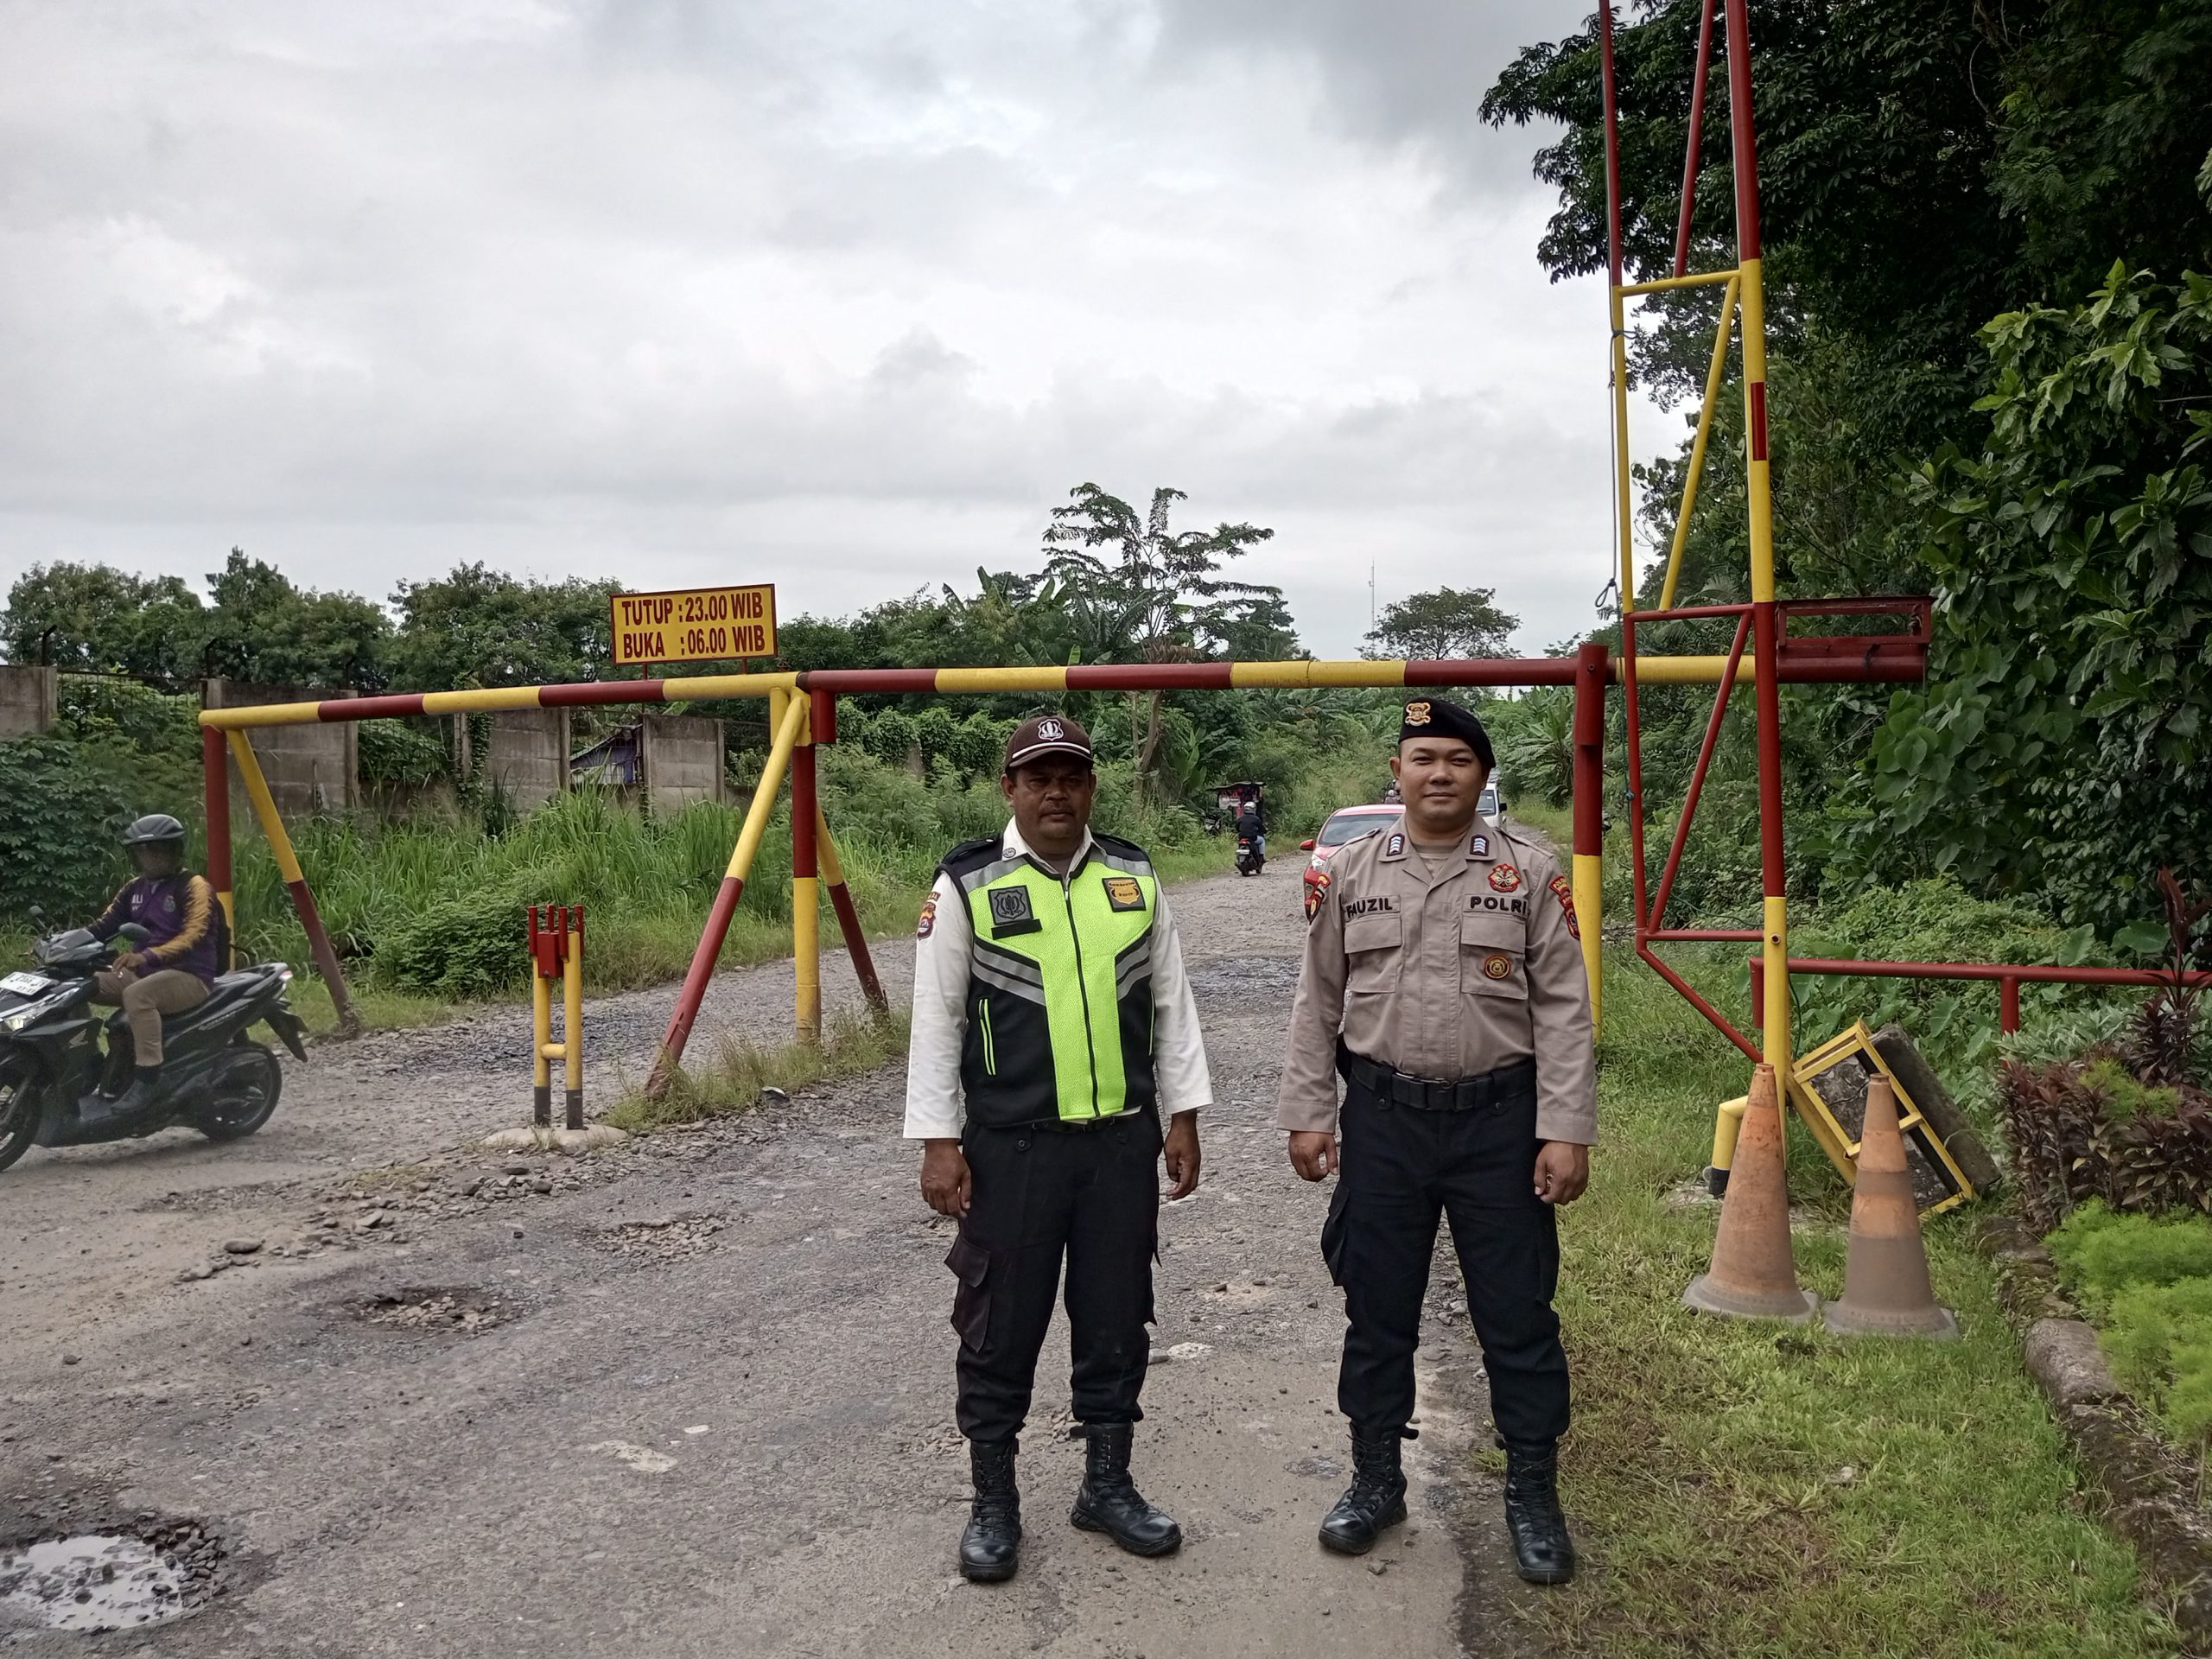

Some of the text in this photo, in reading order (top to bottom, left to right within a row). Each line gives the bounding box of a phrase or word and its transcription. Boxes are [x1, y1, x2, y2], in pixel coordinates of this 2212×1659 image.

[621, 598, 673, 626] TUTUP
[730, 592, 764, 620] WIB
[623, 632, 665, 658] BUKA
[732, 625, 766, 652] WIB
[1345, 898, 1393, 918] FAUZIL
[1470, 896, 1527, 915] POLRI
